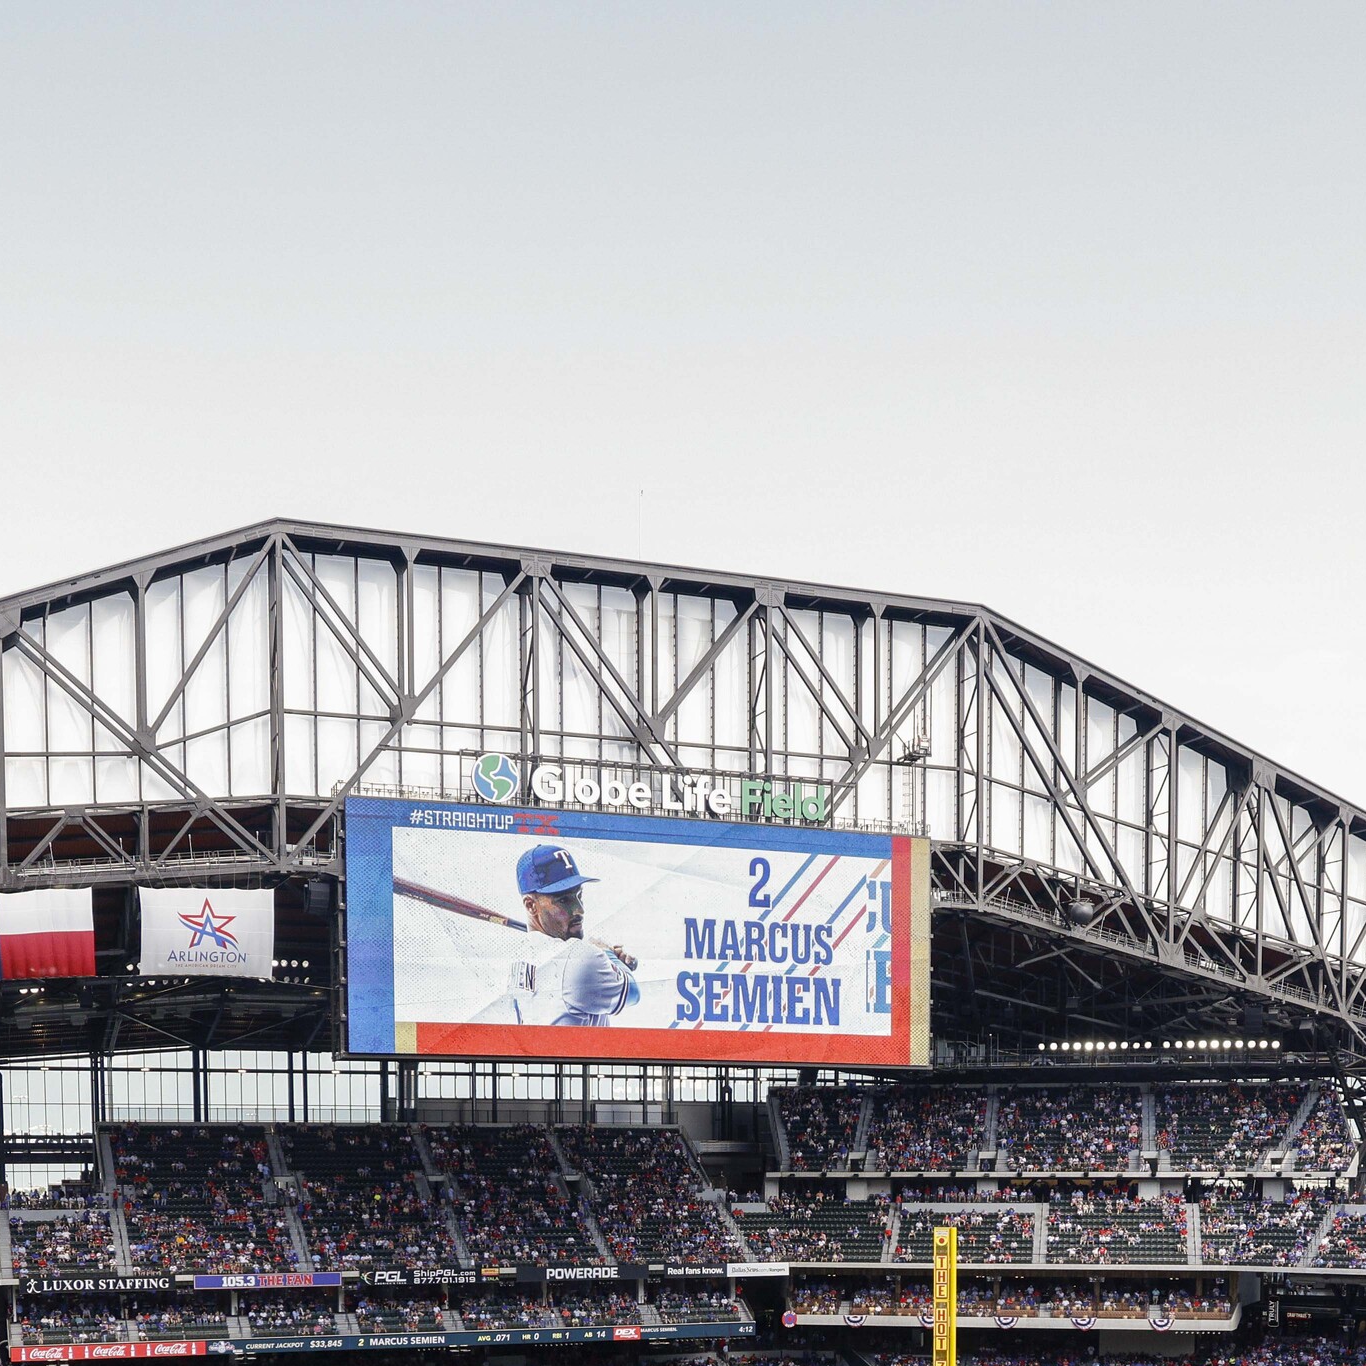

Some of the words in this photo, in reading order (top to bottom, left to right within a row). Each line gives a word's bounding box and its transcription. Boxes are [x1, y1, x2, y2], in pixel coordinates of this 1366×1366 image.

[532, 764, 651, 808] Globe
[662, 774, 731, 814] Life
[741, 780, 825, 821] Field
[748, 857, 771, 908] 2
[683, 916, 833, 966] MARCUS
[167, 950, 247, 963] ARLINGTON
[676, 970, 841, 1026] SEMIEN
[375, 1270, 407, 1283] PGL
[413, 1268, 476, 1278] ShipPGL.com
[546, 1266, 620, 1279] POWERADE
[667, 1266, 682, 1276] Real
[684, 1267, 699, 1275] fans
[701, 1267, 724, 1275] know.
[936, 1256, 947, 1297] THE
[42, 1279, 93, 1292] LUXOR
[98, 1277, 170, 1290] STAFFING
[222, 1275, 255, 1287] 105.3
[258, 1275, 282, 1286] THE
[286, 1274, 313, 1285] FAN
[413, 1275, 476, 1284] 877.701.1919
[936, 1309, 947, 1350] HOT
[246, 1341, 274, 1349] CURRENT
[276, 1340, 304, 1349] JACKPOT
[310, 1339, 342, 1348] $33,845
[357, 1338, 364, 1346] 2
[370, 1336, 409, 1346] MARCUS
[411, 1335, 445, 1345] SEMIEN
[29, 1347, 63, 1359] Coca-Cola
[92, 1346, 126, 1358] Coca-Cola
[154, 1344, 187, 1355] Coca-Cola
